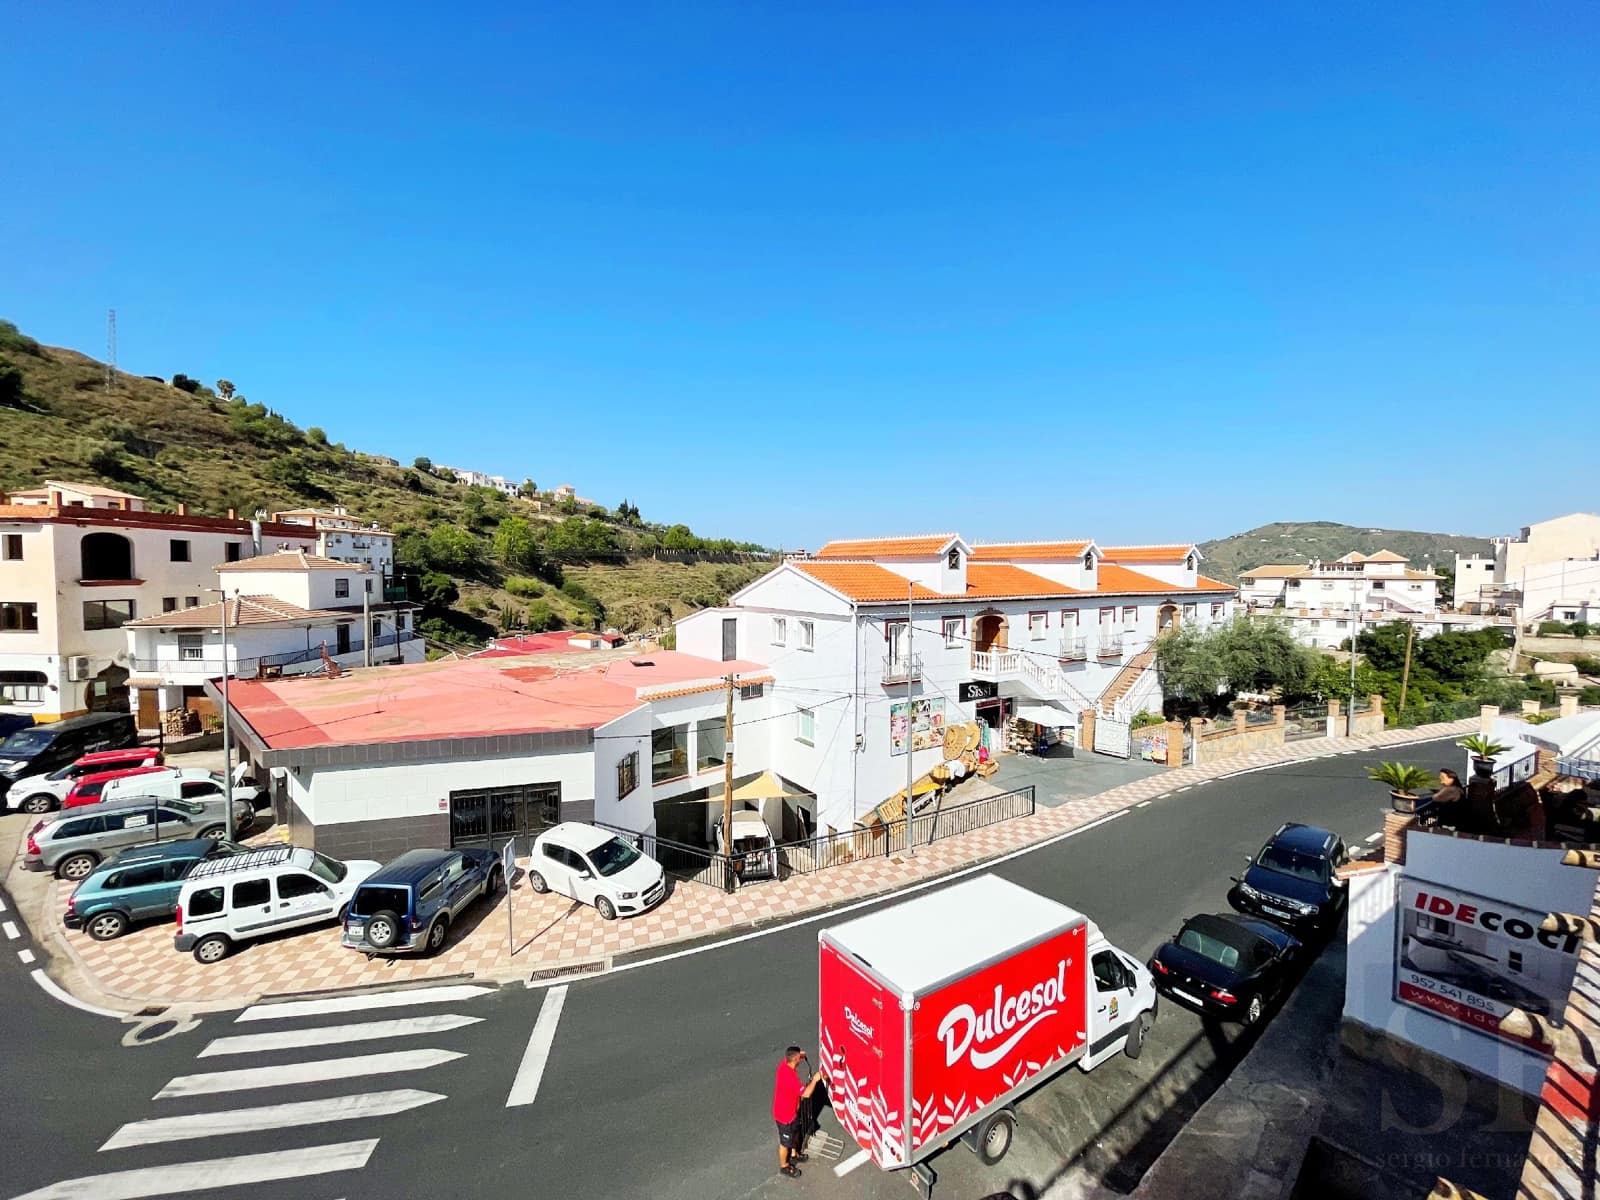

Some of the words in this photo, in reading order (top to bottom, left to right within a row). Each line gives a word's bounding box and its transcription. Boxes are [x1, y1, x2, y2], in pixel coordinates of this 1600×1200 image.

[1411, 974, 1435, 989] 952
[1439, 985, 1462, 999] 541
[1466, 994, 1494, 1011] 895
[844, 1006, 873, 1038] Dulcesol
[937, 960, 1066, 1067] Dulcesol
